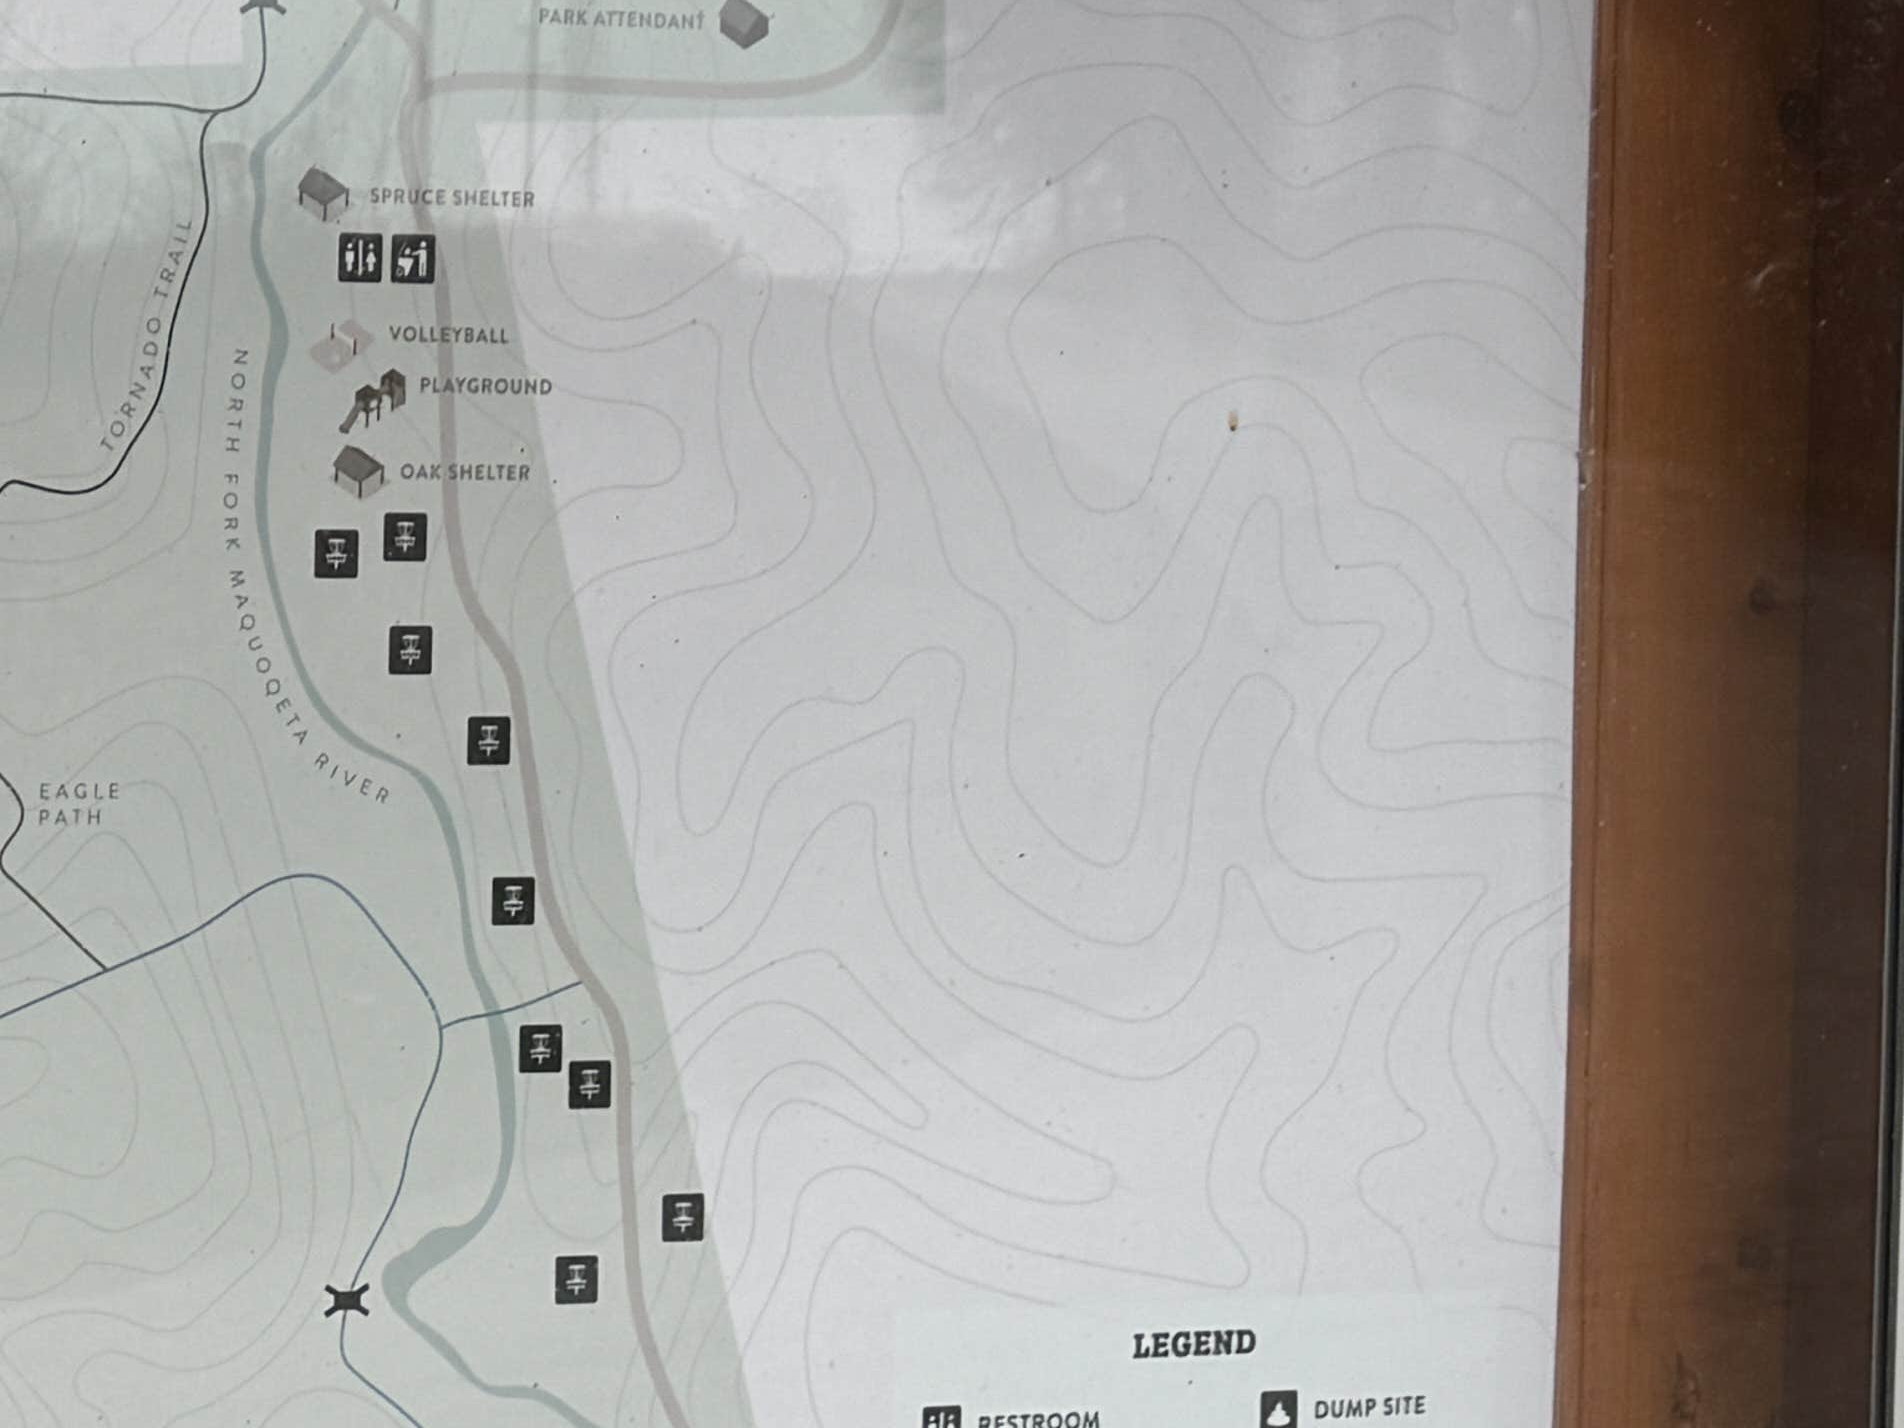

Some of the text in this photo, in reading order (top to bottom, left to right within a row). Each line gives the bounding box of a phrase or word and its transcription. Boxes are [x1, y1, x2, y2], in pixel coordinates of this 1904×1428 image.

[538, 7, 704, 30] PARK ATTENDANT
[370, 188, 535, 209] SPRUCE SHELTER
[100, 220, 192, 452] TORNADO TRAIL
[389, 325, 509, 345] VOLLEYBALL
[420, 376, 553, 397] PLAYGROUND
[401, 463, 530, 482] OAK SHELTER
[223, 349, 390, 805] NORTH FORK MAQUOQETA RIVER
[39, 782, 119, 800] EAGLE
[39, 808, 101, 826] PATH
[1132, 1329, 1256, 1359] LEGEND
[1313, 1395, 1427, 1420] DUMP SITE
